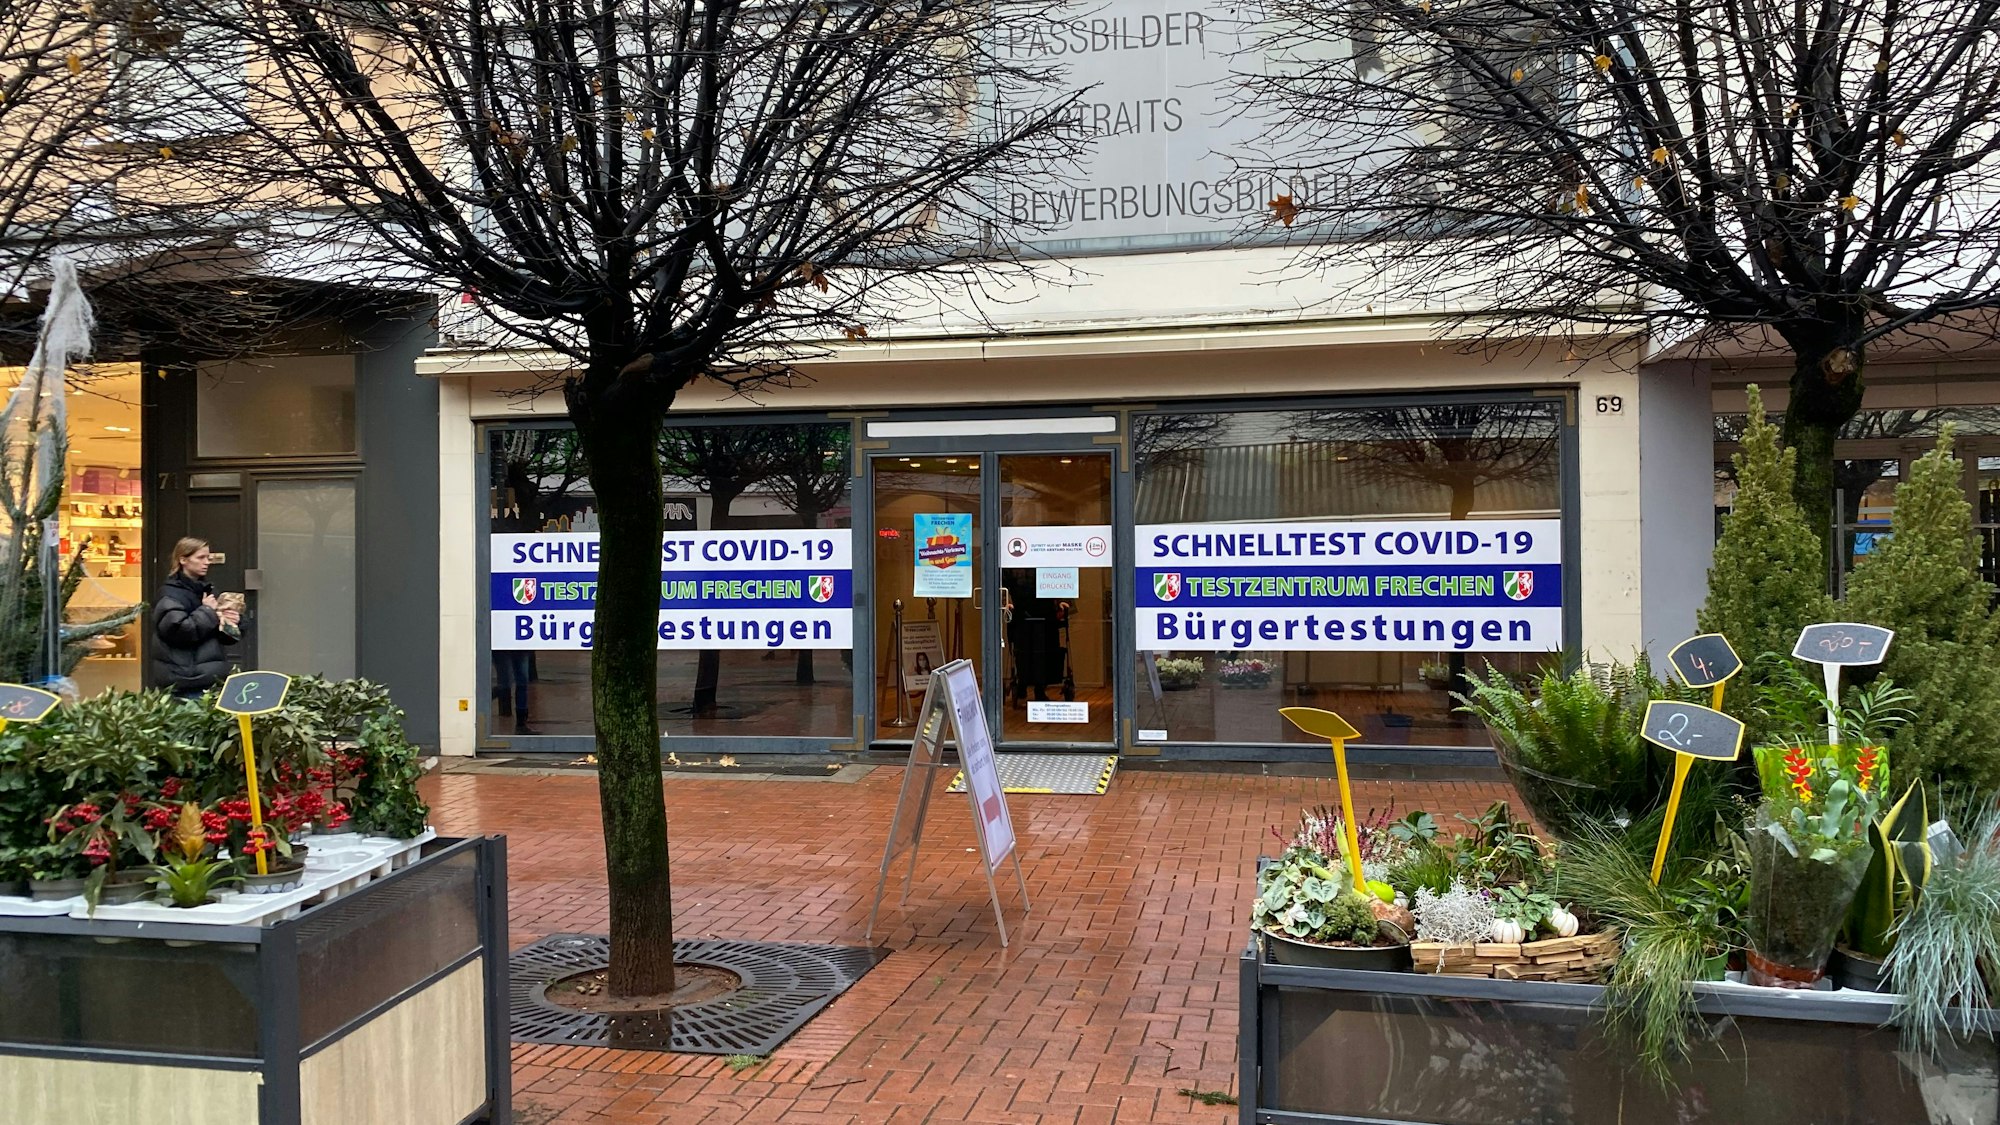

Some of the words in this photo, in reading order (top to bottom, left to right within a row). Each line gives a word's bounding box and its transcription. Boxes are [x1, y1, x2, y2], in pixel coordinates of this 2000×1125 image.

[1009, 11, 1204, 58] PASSBILDER
[1010, 97, 1183, 140] PORTRAITS
[1596, 396, 1622, 412] 69
[513, 540, 694, 564] SCHNEST
[702, 539, 834, 561] COVID-19
[1153, 532, 1366, 557] SCHNELLTEST
[1375, 531, 1533, 555] COVID-19
[1040, 582, 1074, 590] (DRÜCKEN)
[1042, 572, 1072, 580] EINGANG
[1186, 576, 1369, 597] TESTZENTRUM
[1375, 575, 1494, 597] FRECHEN
[540, 581, 698, 601] TESTUM
[702, 579, 802, 599] FRECHEN
[515, 613, 832, 647] Bürgestungen
[1156, 612, 1531, 649] Bürgertestungen
